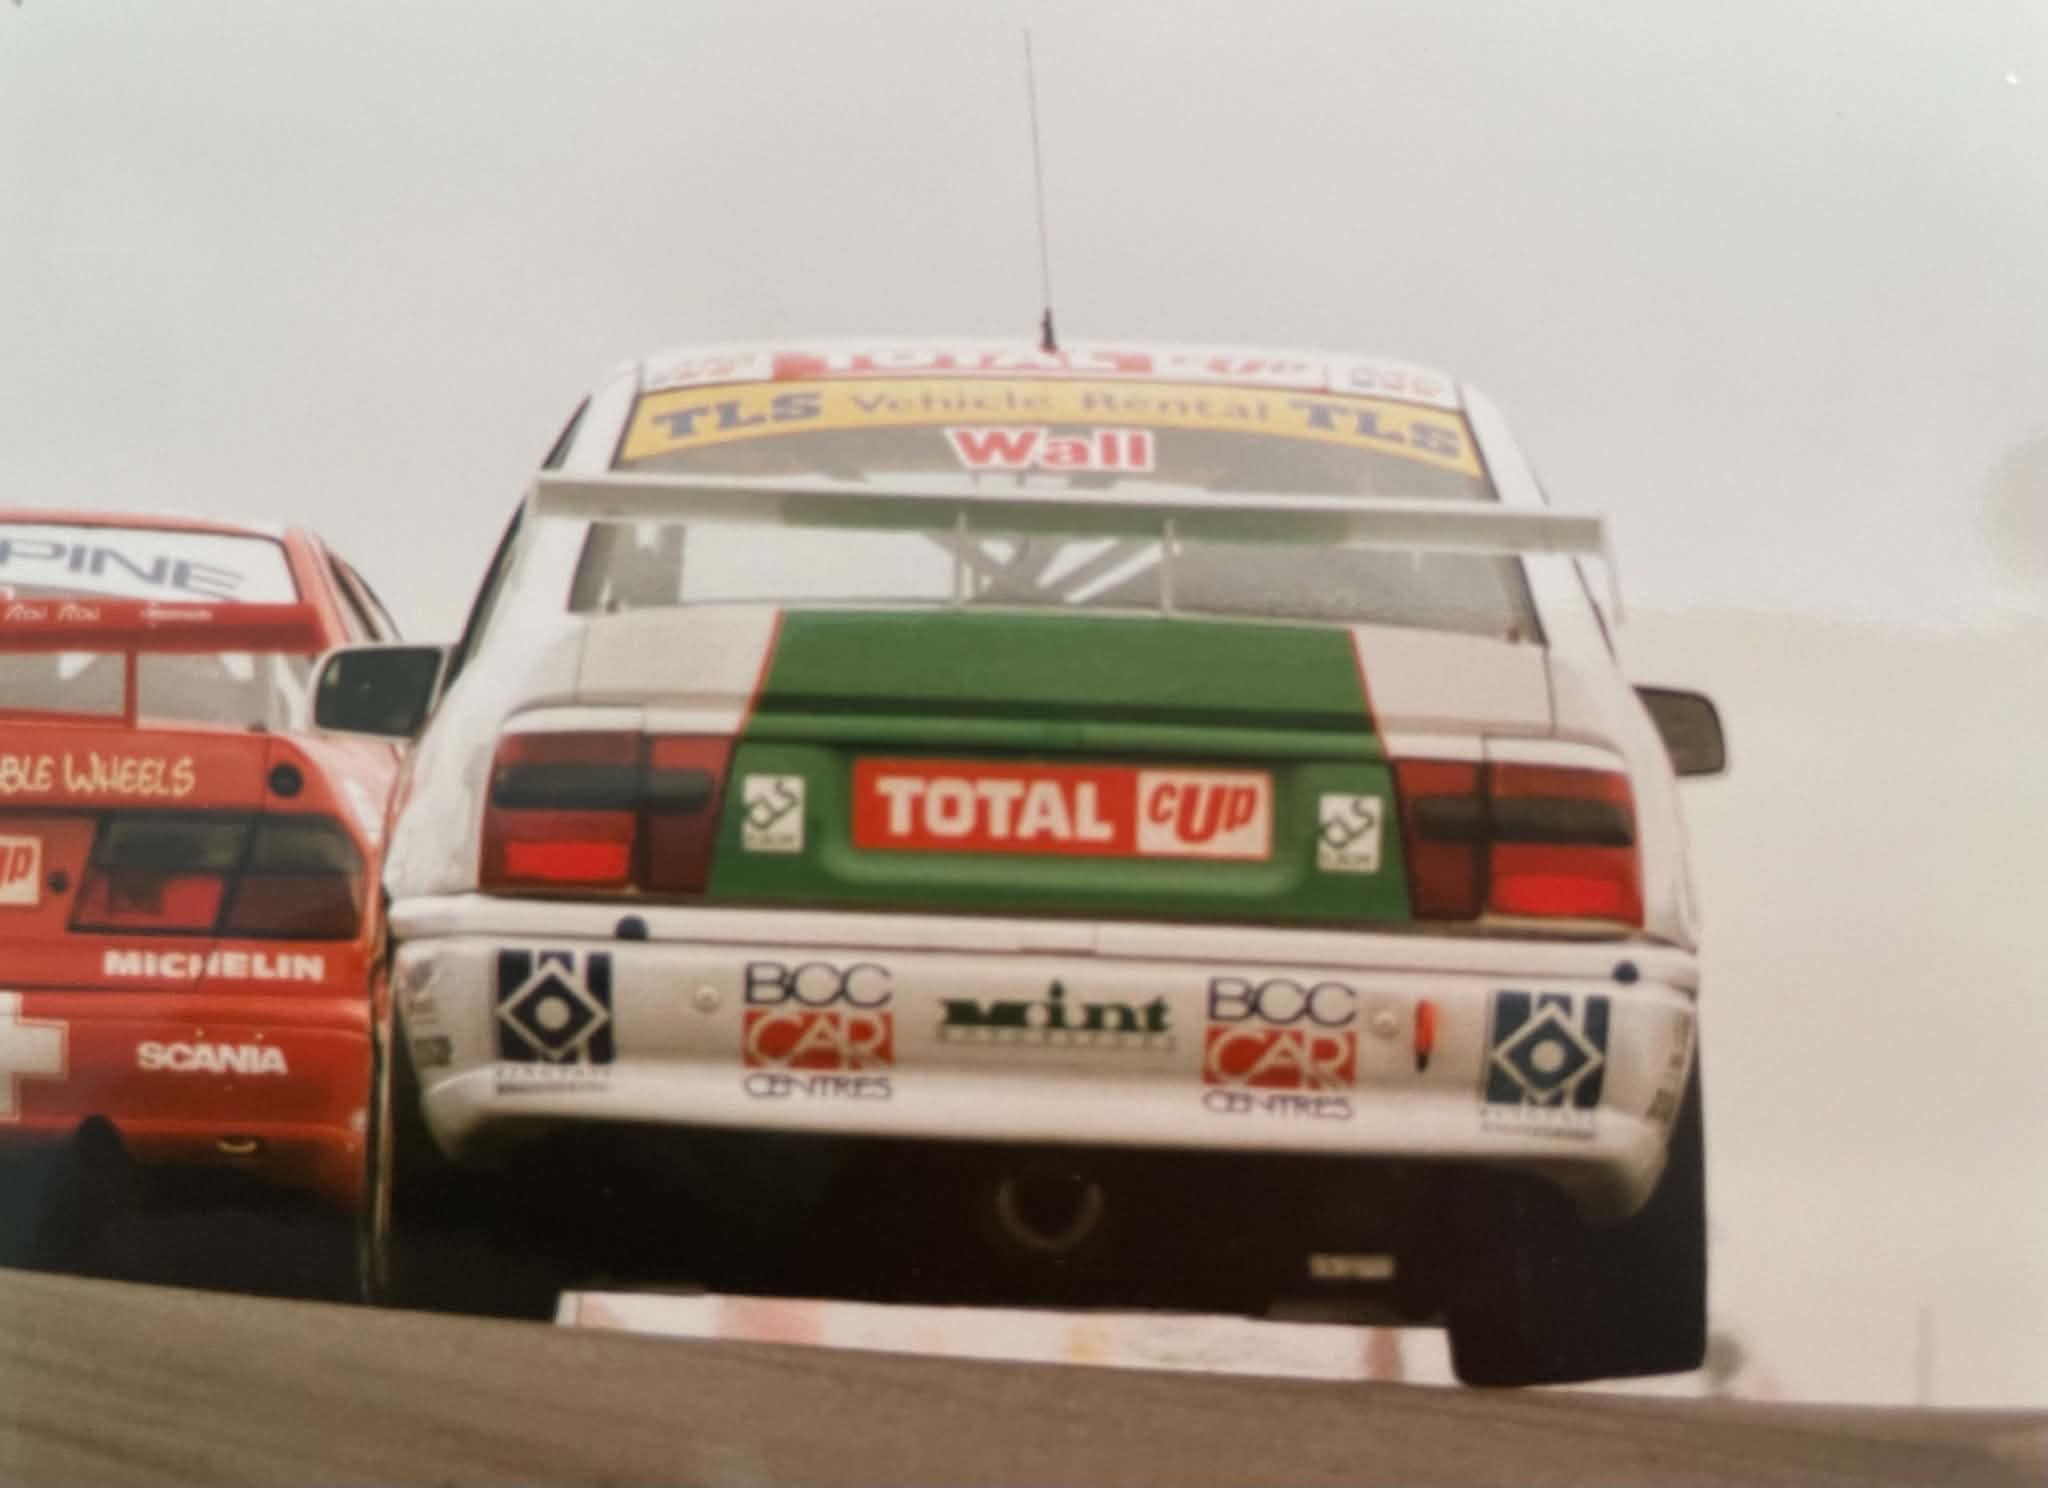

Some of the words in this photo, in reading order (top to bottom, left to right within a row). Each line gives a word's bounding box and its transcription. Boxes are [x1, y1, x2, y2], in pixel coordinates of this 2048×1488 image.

[652, 391, 822, 440] TLS
[1286, 397, 1461, 460] TLS
[952, 428, 1150, 472] Wall
[62, 752, 197, 798] WHEELS
[874, 774, 1114, 842] TOTAL
[1147, 783, 1258, 844] CUP
[103, 949, 325, 982] MICHELIN
[937, 980, 1171, 1033] Mint
[136, 1040, 288, 1075] SCANIA
[750, 1010, 892, 1072] CAR
[1208, 1026, 1355, 1090] CAR
[743, 1072, 892, 1101] CENTRES
[1203, 1088, 1355, 1120] CENTRES
